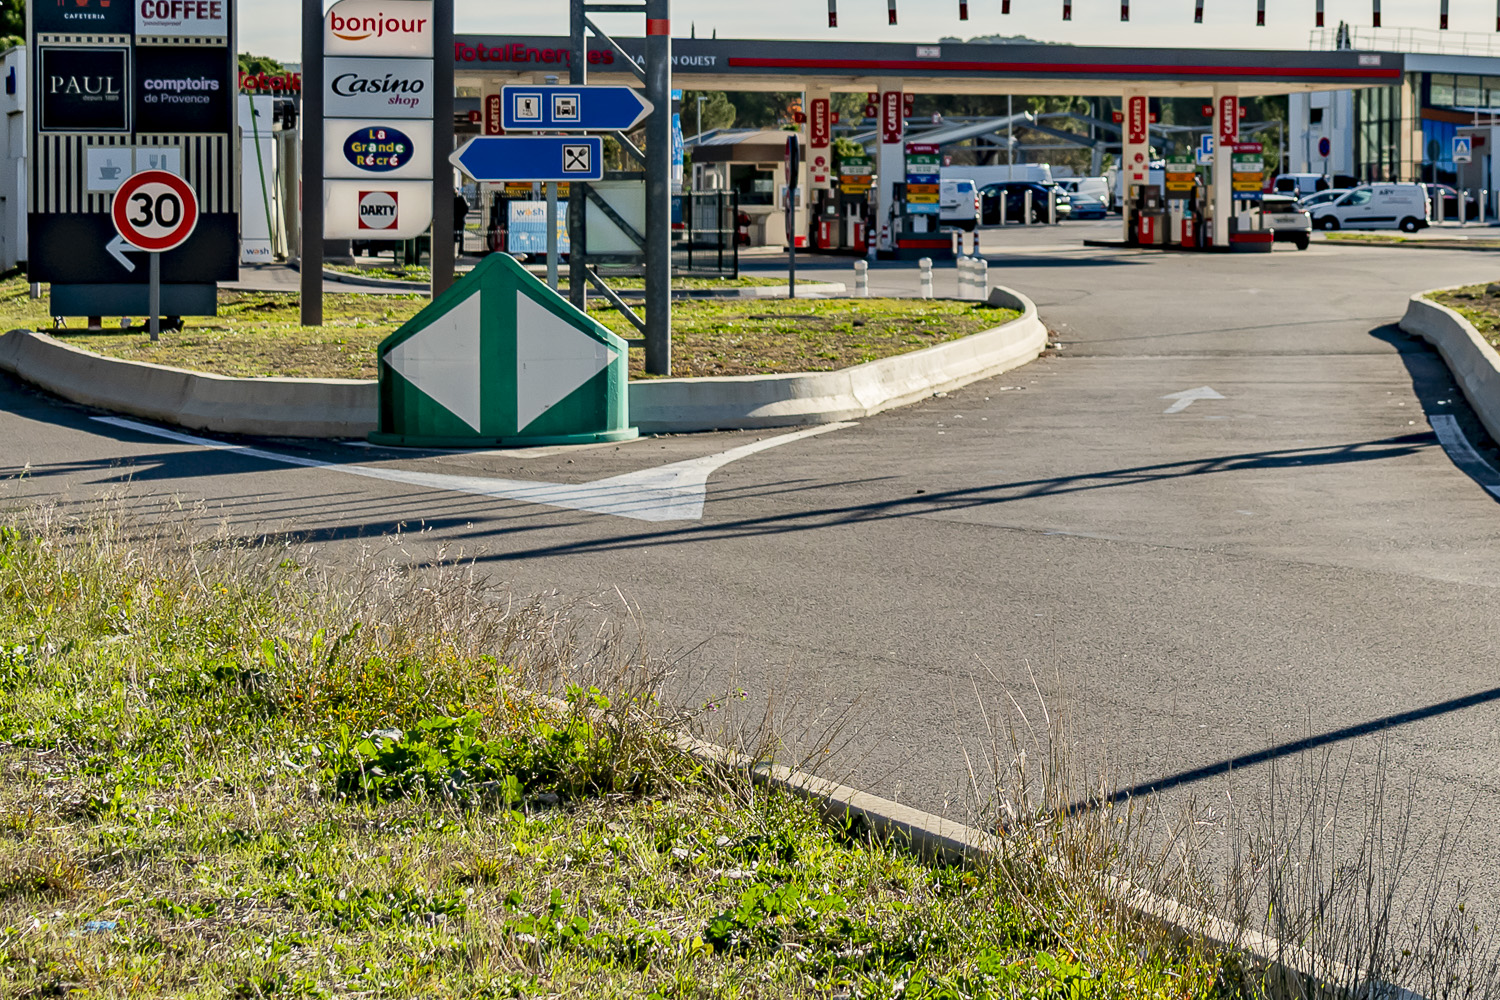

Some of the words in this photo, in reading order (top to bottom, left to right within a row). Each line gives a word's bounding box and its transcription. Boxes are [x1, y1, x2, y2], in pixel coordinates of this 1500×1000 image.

[64, 12, 105, 20] CAFETERIA
[141, 0, 222, 20] COFFEE
[331, 11, 427, 38] bonjour
[680, 55, 717, 66] OUEST
[50, 76, 121, 94] PAUL
[144, 77, 219, 93] comptoirs
[331, 73, 424, 97] Casino
[144, 94, 158, 103] de
[161, 94, 210, 103] Provence
[387, 94, 420, 109] shop
[490, 97, 500, 134] CARTES
[815, 101, 825, 136] CARTES
[887, 93, 897, 131] CARTES
[1133, 98, 1142, 133] CARTES
[1224, 98, 1233, 134] CARTES
[369, 129, 386, 140] La
[351, 142, 405, 153] Grande
[356, 153, 399, 166] Récré
[129, 192, 181, 228] 30
[360, 205, 396, 216] DARTY
[246, 247, 269, 256] wash
